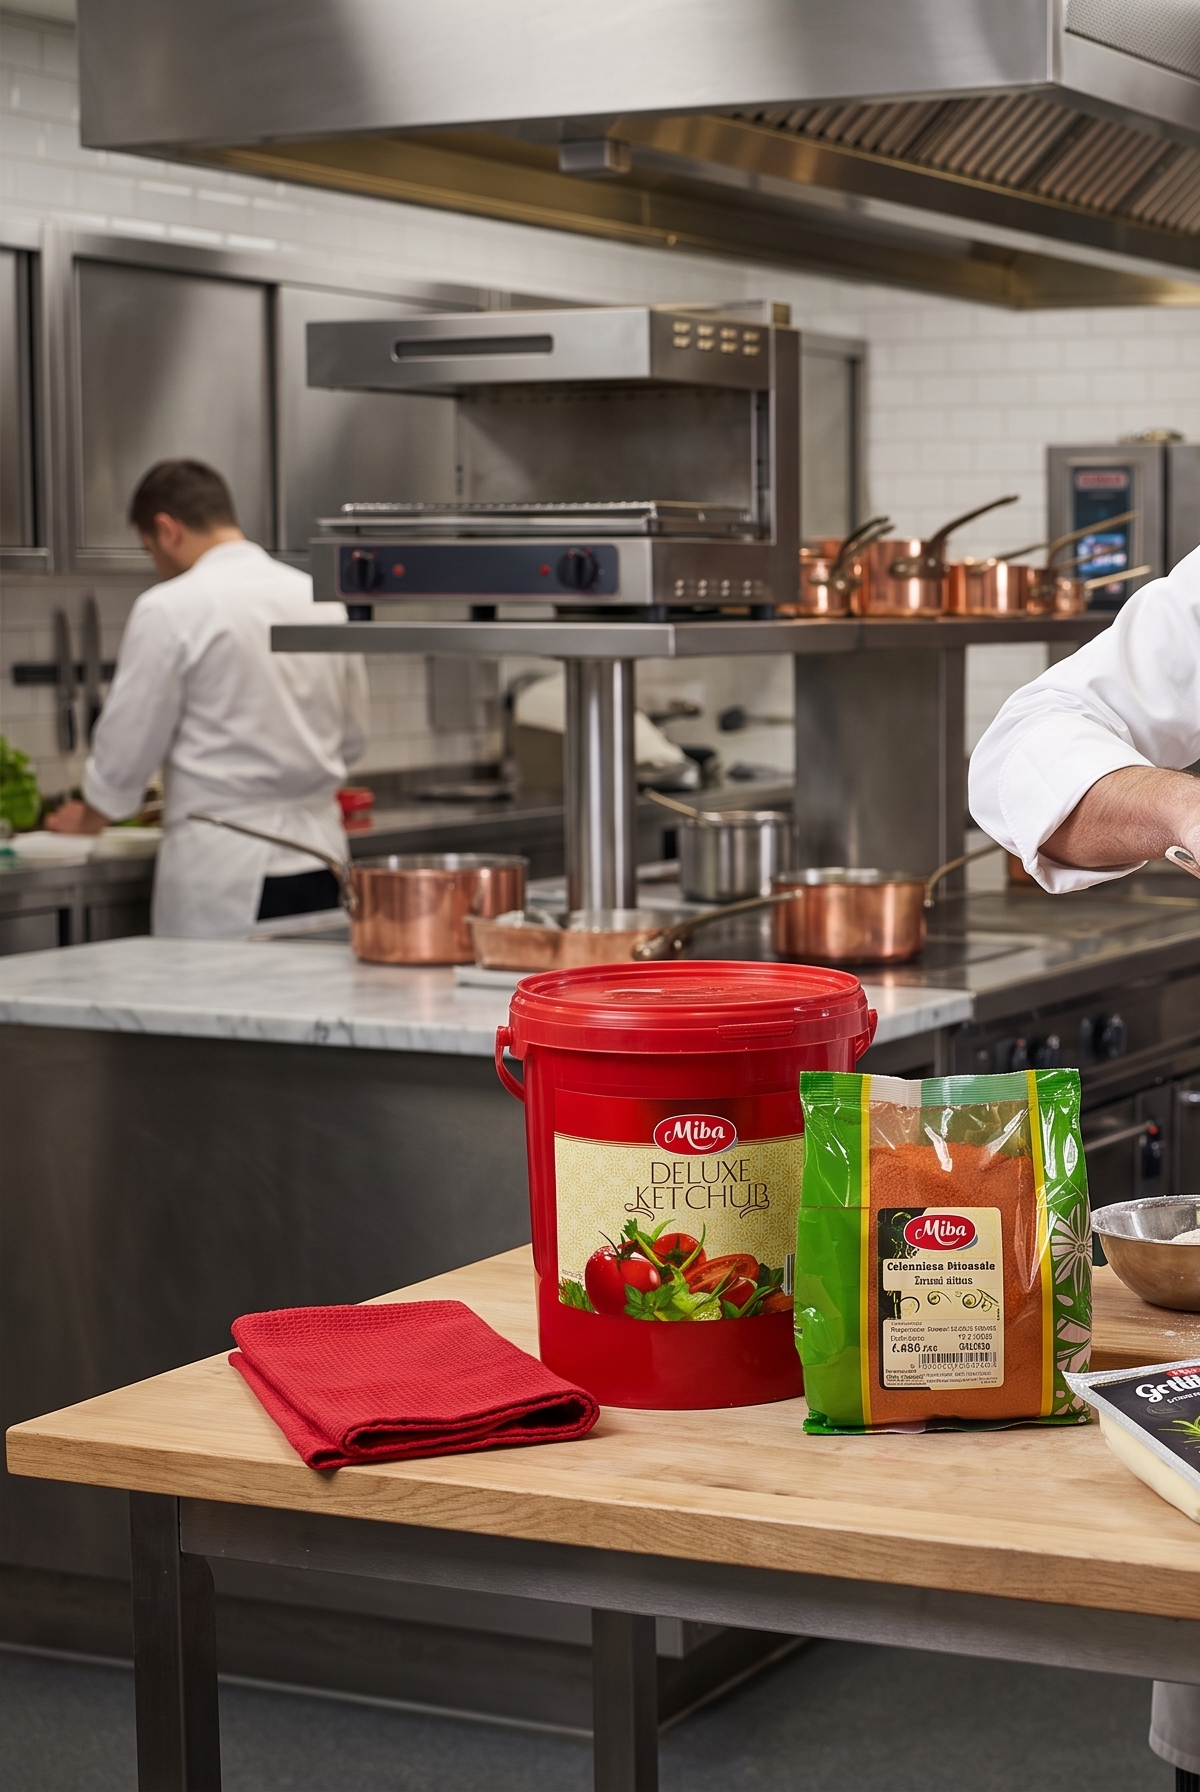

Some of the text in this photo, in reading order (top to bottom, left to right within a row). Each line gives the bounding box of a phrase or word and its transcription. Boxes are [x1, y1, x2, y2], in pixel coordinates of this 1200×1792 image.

[664, 1120, 726, 1150] Miba
[651, 1158, 751, 1185] DELUXE
[624, 1182, 770, 1221] KETCHUB
[914, 1218, 967, 1246] Miba
